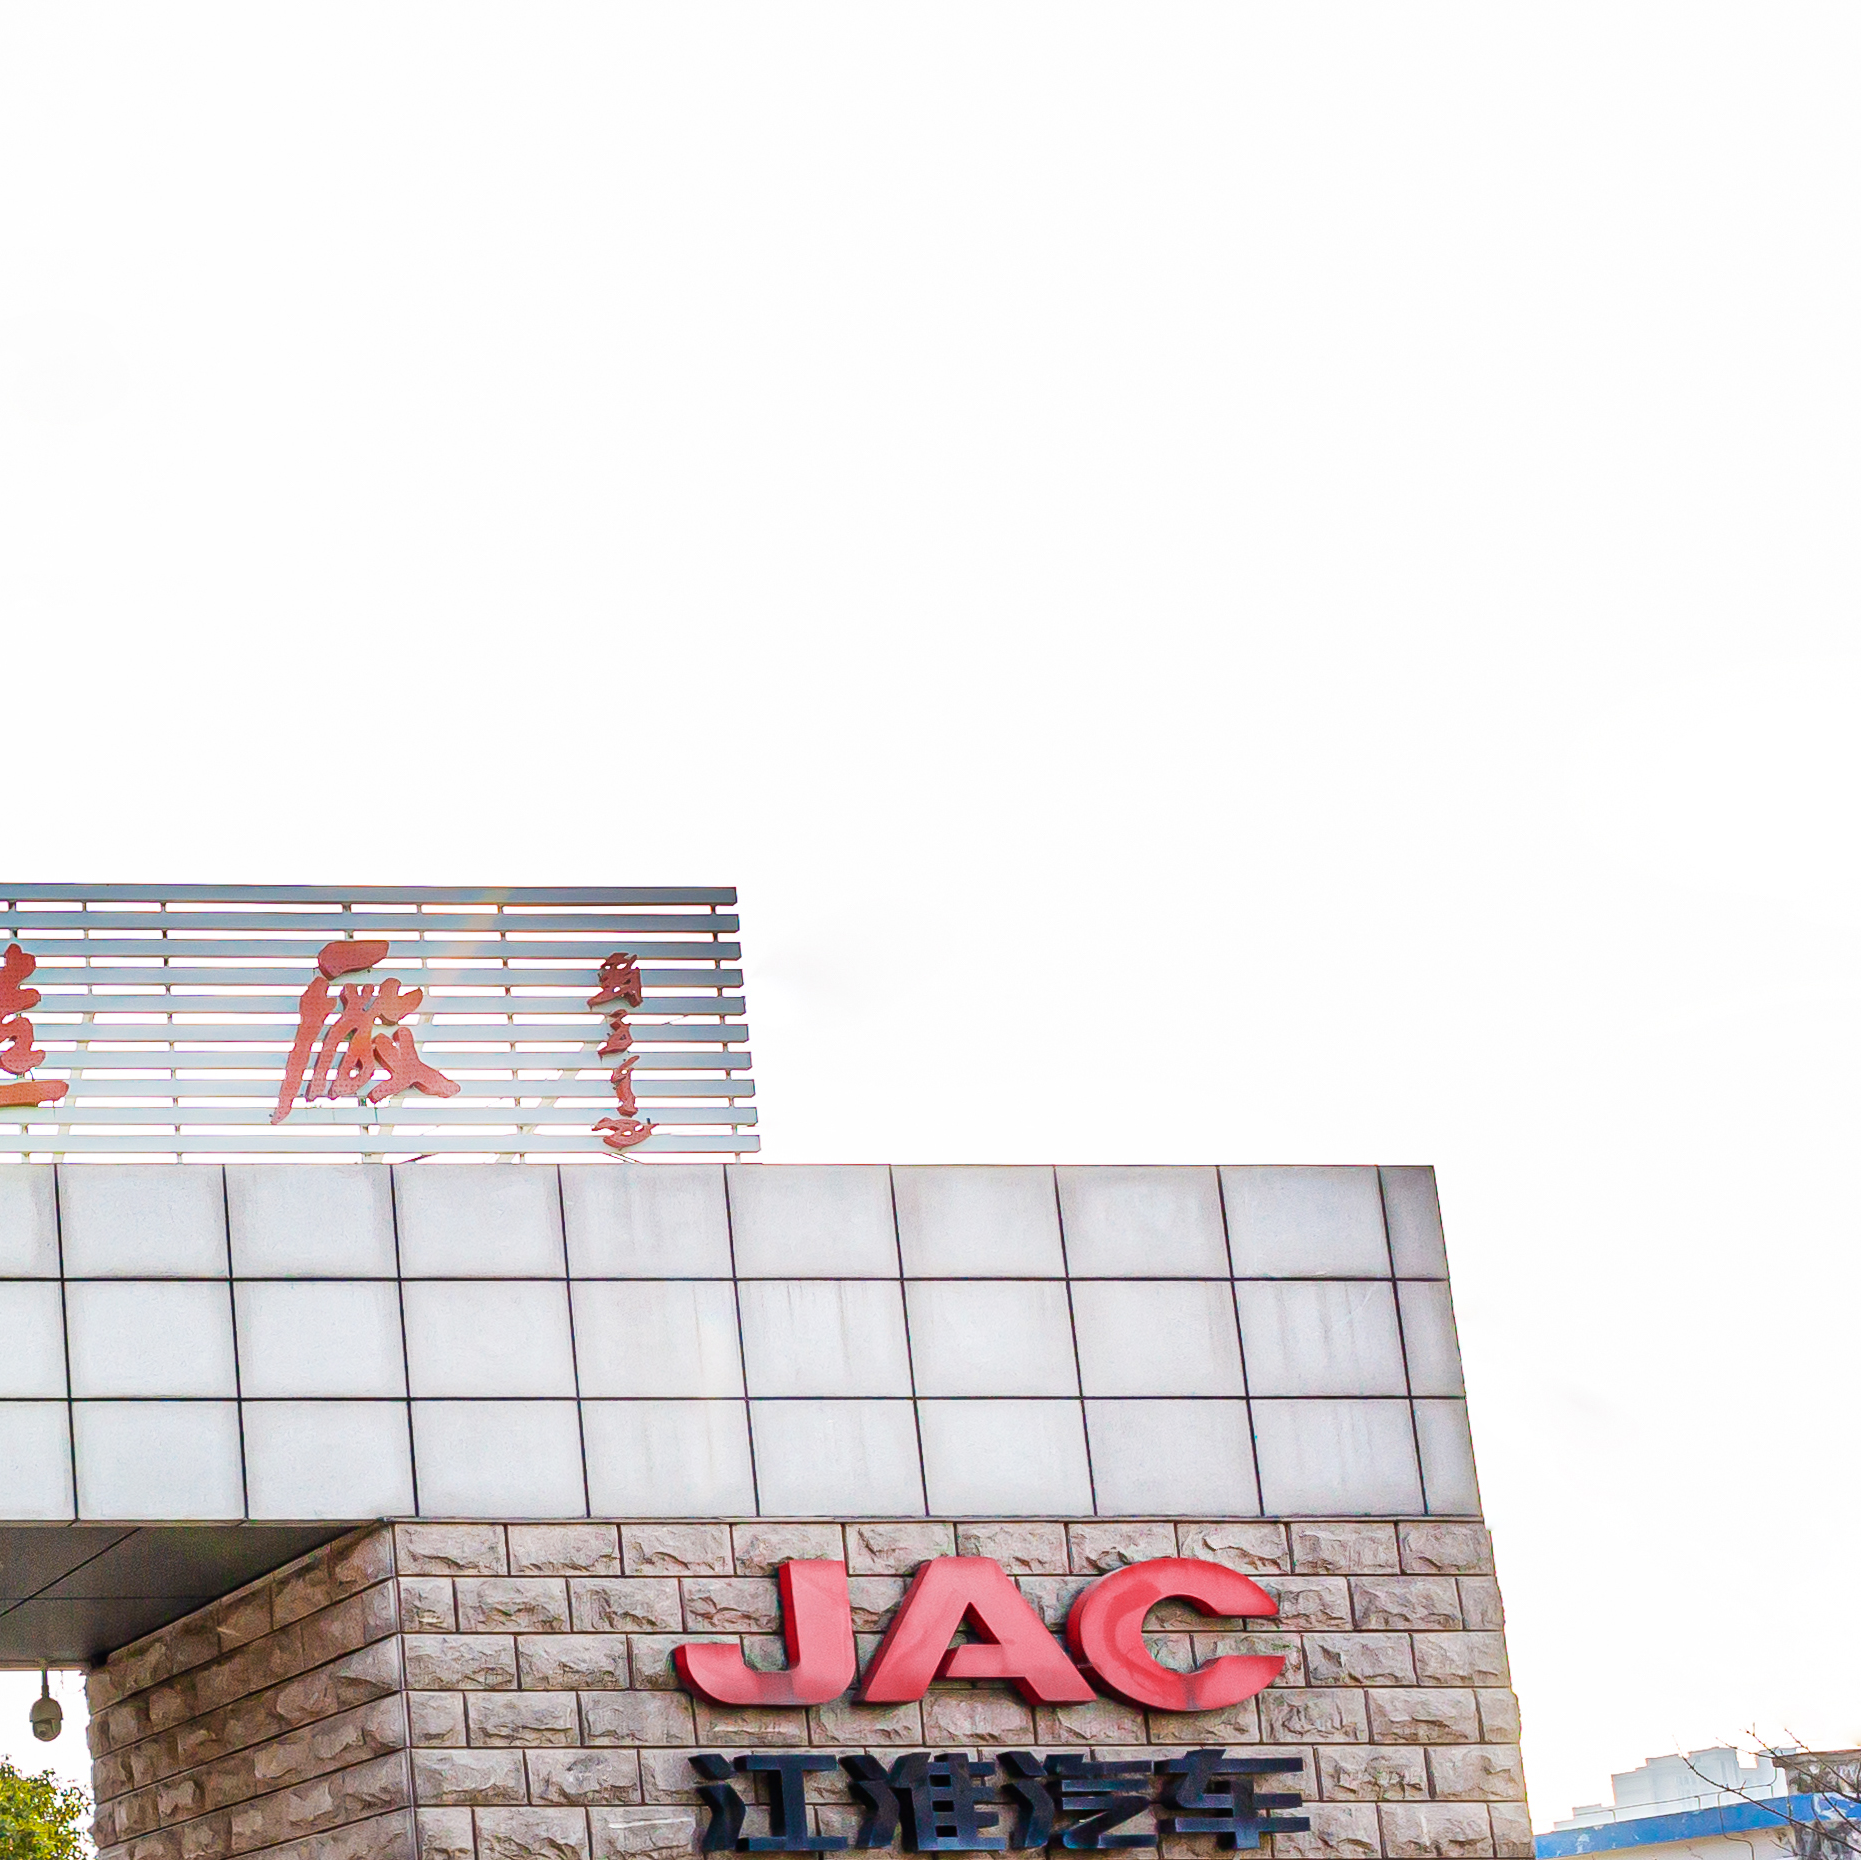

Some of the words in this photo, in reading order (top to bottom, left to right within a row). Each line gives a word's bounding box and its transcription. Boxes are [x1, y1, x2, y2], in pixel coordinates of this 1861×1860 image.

[674, 1555, 1286, 1713] JAC
[687, 1748, 1311, 1853] 江淮汽车
